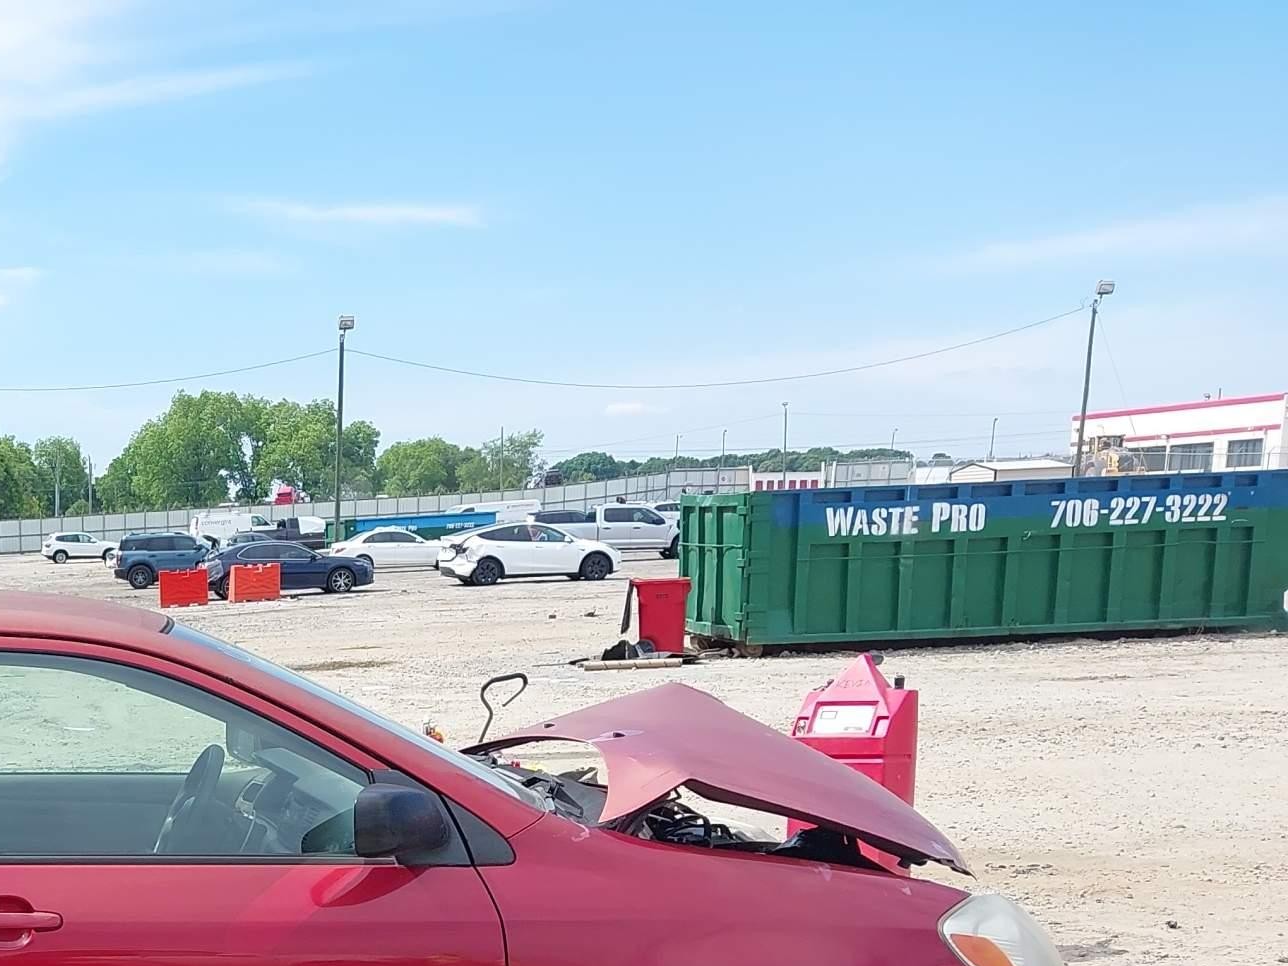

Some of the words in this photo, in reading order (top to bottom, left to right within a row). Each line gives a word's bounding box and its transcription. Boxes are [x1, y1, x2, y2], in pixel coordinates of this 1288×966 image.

[825, 505, 920, 537] WASTE
[931, 502, 986, 533] PRO
[1050, 493, 1228, 529] 706-227-3222
